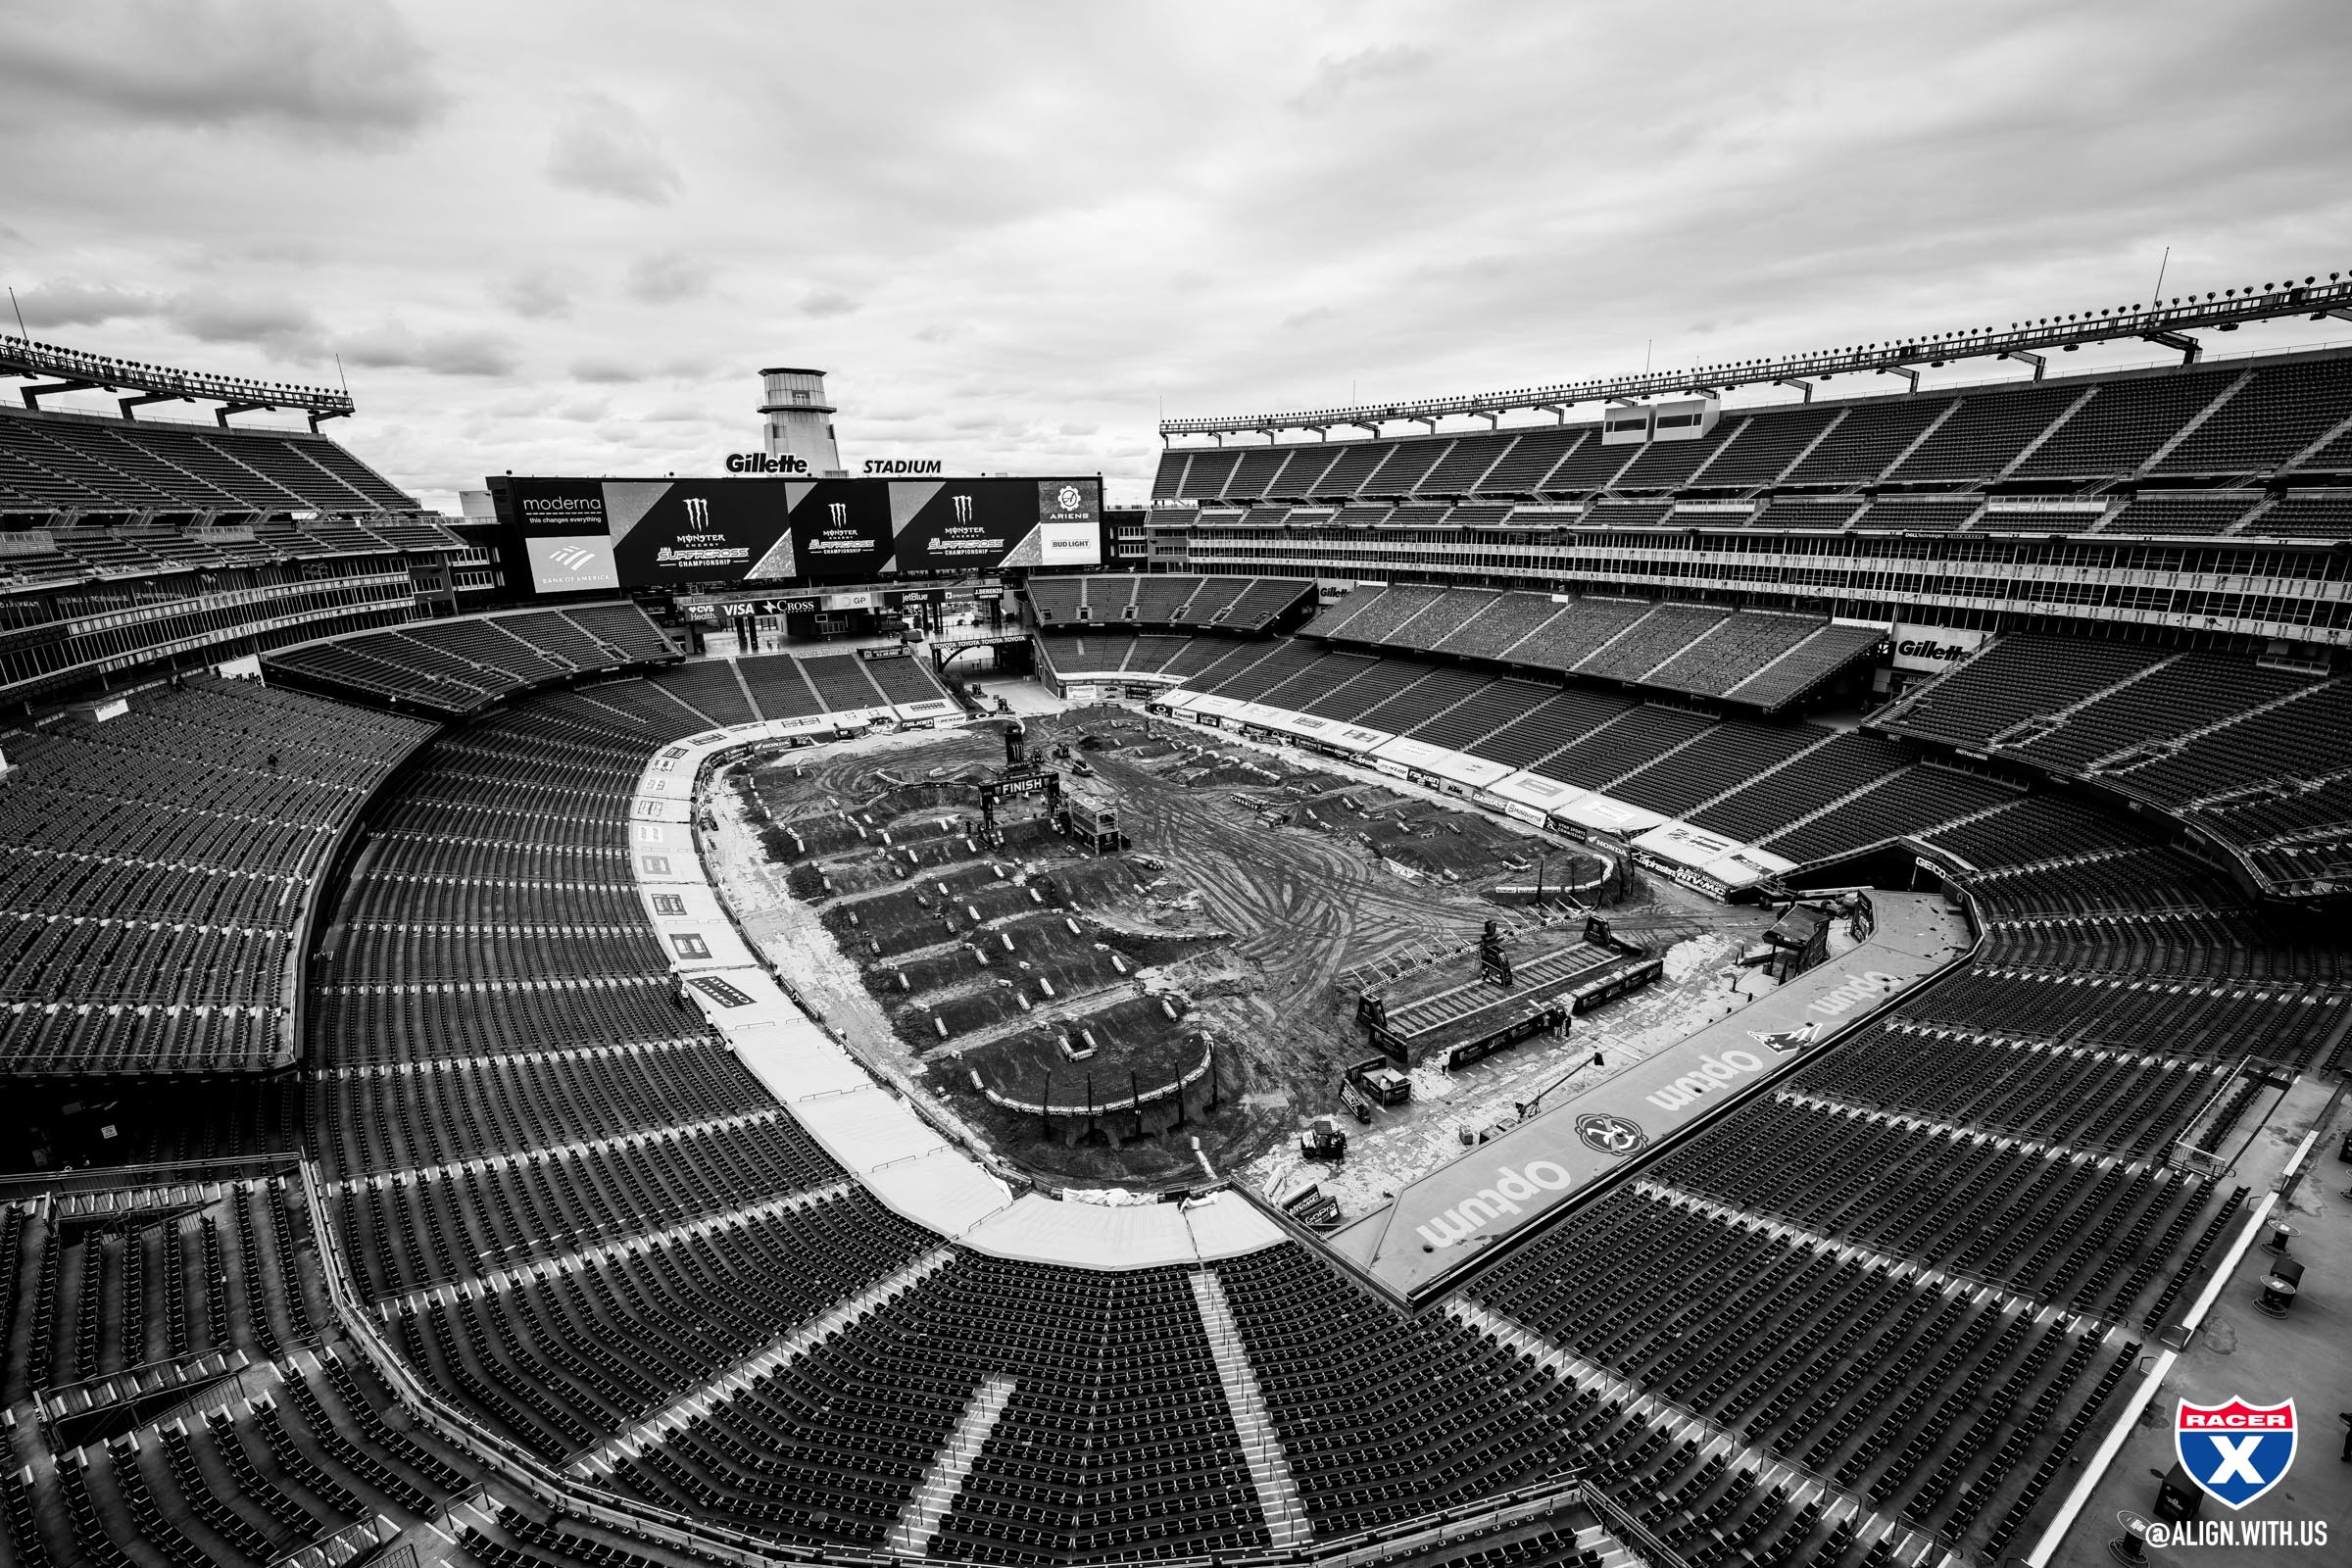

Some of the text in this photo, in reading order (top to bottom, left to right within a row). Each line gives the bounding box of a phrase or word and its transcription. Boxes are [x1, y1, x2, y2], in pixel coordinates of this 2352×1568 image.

[725, 452, 942, 474] Gillette STADIUM
[522, 496, 602, 511] moderna
[569, 515, 602, 524] everything
[808, 540, 875, 550] SUPERCROSS
[927, 539, 1004, 550] SUPERCROSS
[657, 548, 750, 562] SUPERCROSS
[678, 559, 731, 567] CHAMPIONSHIP
[903, 593, 928, 603] jetBlue
[721, 603, 755, 616] VISA
[1408, 770, 1440, 784] FALKEN
[1003, 778, 1043, 795] FINISH
[1447, 785, 1463, 795] KTM
[1473, 793, 1506, 808] GASGAS
[1514, 807, 1542, 823] Husqvarna
[1557, 827, 1586, 841] COMMISSION
[1595, 839, 1628, 858] HONDA
[1915, 856, 1945, 879] GEICO
[1807, 969, 1900, 1017] Optum
[1645, 1050, 1764, 1111] Optum
[1416, 1160, 1571, 1250] Optum
[1304, 1202, 1337, 1224] GoPro
